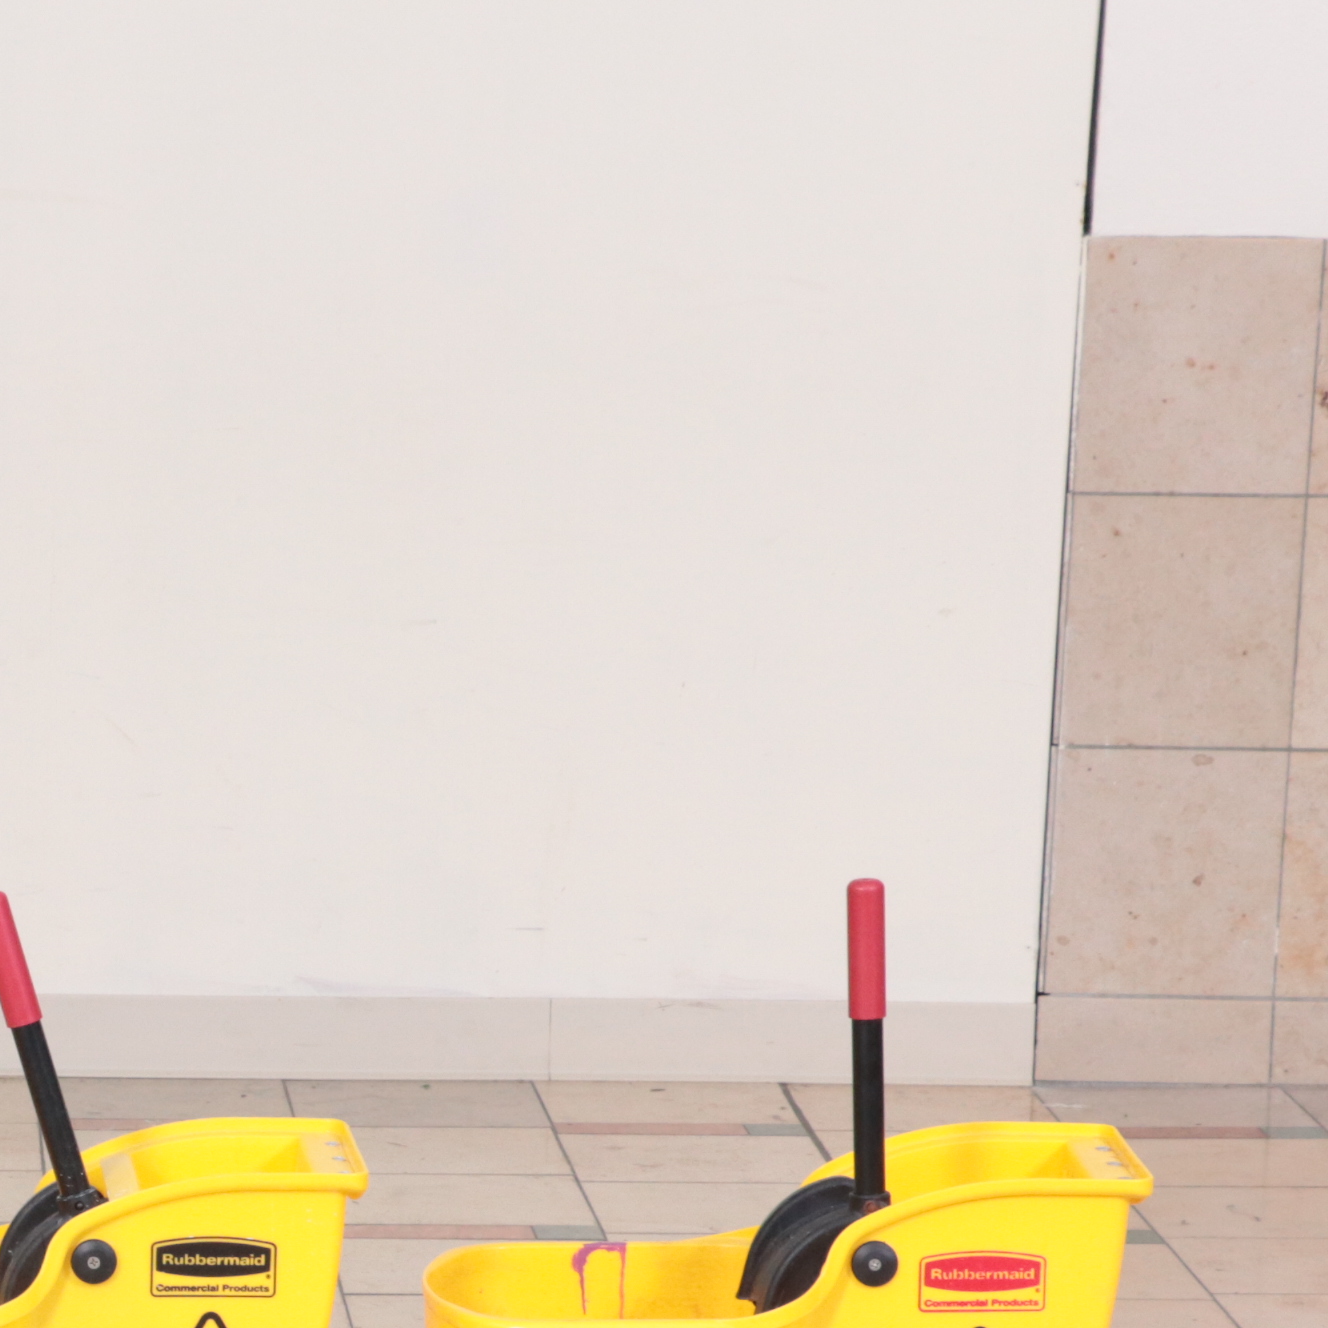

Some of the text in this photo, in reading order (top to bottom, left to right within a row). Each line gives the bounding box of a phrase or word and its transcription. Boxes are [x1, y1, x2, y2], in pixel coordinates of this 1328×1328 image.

[161, 1253, 266, 1266] Rubbermaid
[930, 1267, 1035, 1280] Rubbermaid
[156, 1284, 270, 1293] Commercial Products
[924, 1299, 1039, 1308] Commercial Products
